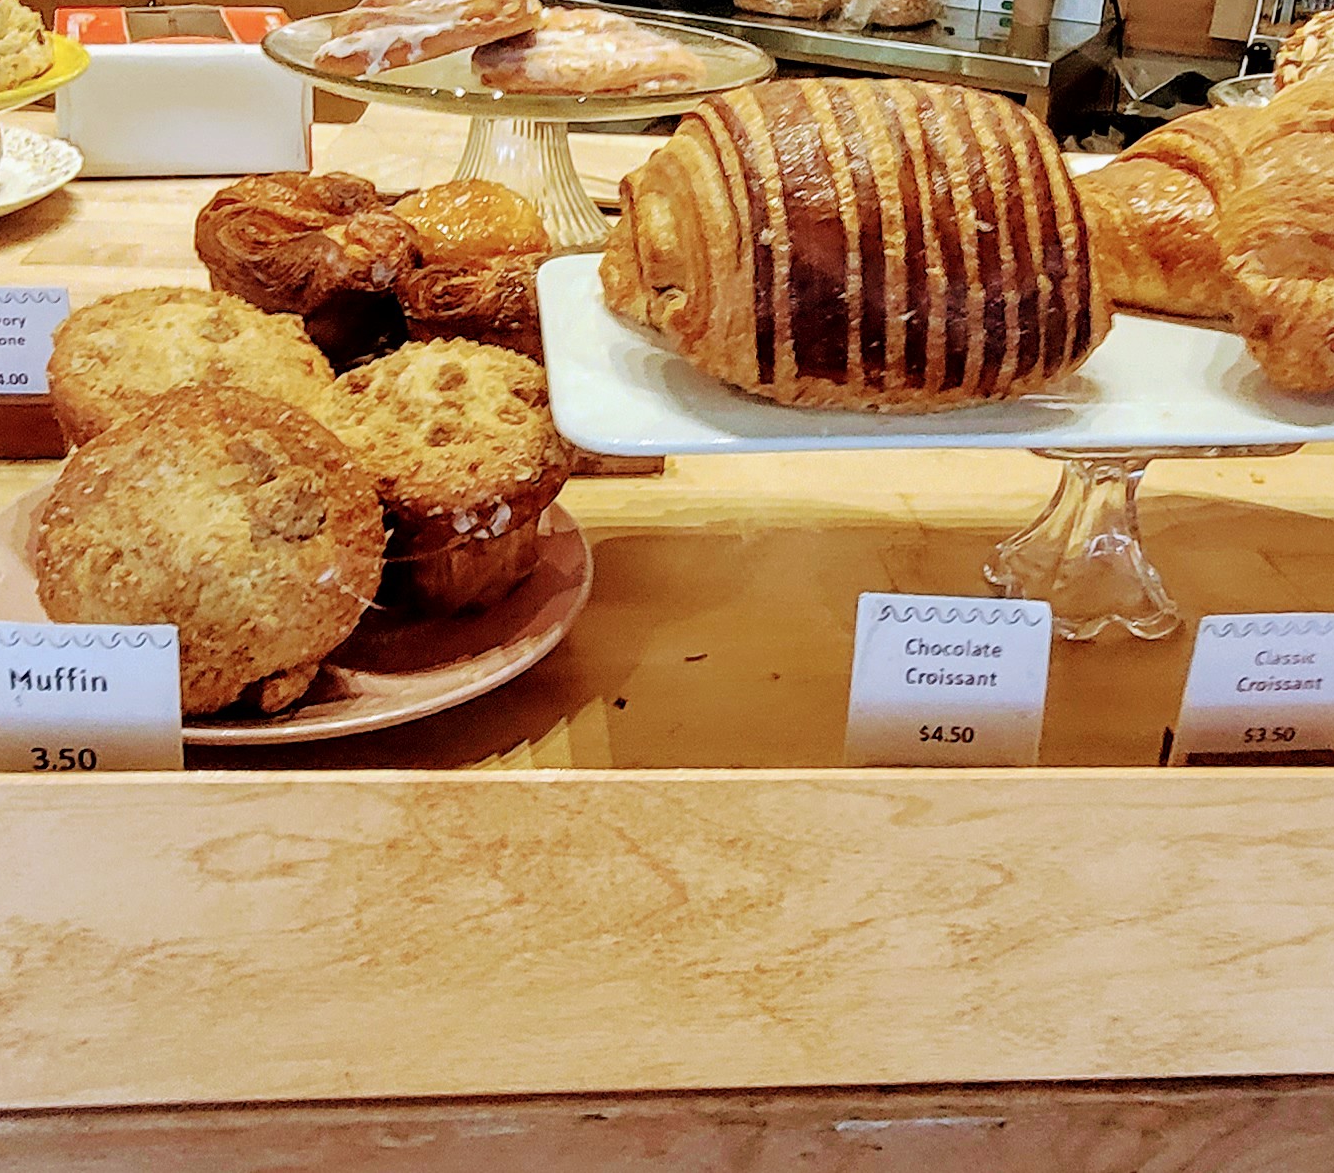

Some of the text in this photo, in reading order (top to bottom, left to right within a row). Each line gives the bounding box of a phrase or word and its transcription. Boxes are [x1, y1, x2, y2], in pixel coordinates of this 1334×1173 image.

[905, 637, 1004, 658] Chocolate
[1254, 649, 1316, 667] Classic
[9, 666, 109, 693] Muffin
[905, 667, 998, 687] Croissant
[1236, 675, 1324, 693] Croissant
[918, 725, 975, 743] $4.50
[29, 745, 98, 771] 3.50
